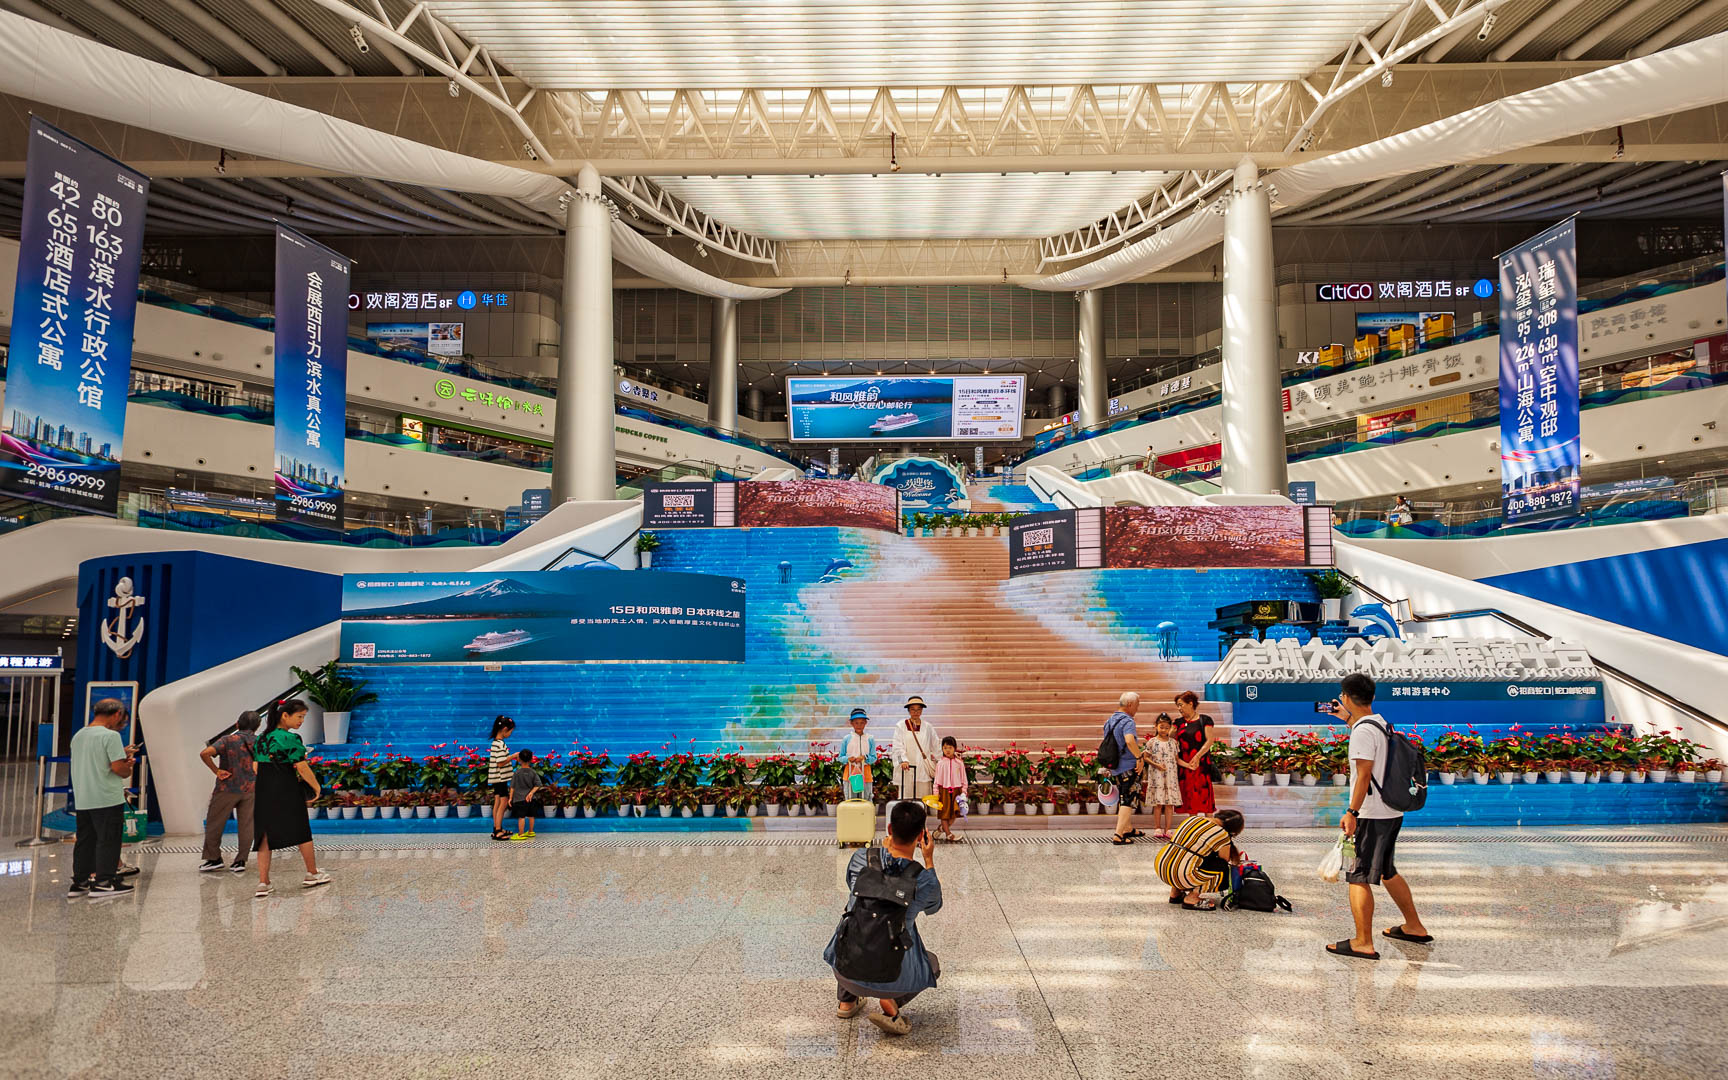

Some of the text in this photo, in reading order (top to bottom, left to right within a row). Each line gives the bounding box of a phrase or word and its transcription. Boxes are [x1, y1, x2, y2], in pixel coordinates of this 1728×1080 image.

[1378, 280, 1451, 298] 欢阁酒店
[1455, 286, 1470, 297] 8F
[37, 238, 75, 372] 酒店式公寓
[366, 292, 437, 310] 欢阁酒店
[439, 299, 453, 309] 8F
[481, 293, 508, 307] 华住
[306, 271, 324, 359] 会展西引力
[77, 257, 115, 411] 滨水行政公馆
[1517, 372, 1535, 444] 山海公寓
[643, 433, 668, 444] COFFEE
[1507, 490, 1572, 511] 400-880-1872
[609, 605, 683, 616] 15日和风雅韵
[1239, 669, 1293, 680] GLOBAL
[1296, 669, 1344, 680] PUBLIC
[1413, 668, 1519, 679] PERFORMANCE
[1525, 667, 1600, 678] PLATFORM
[1391, 686, 1451, 697] 深圳游客中心
